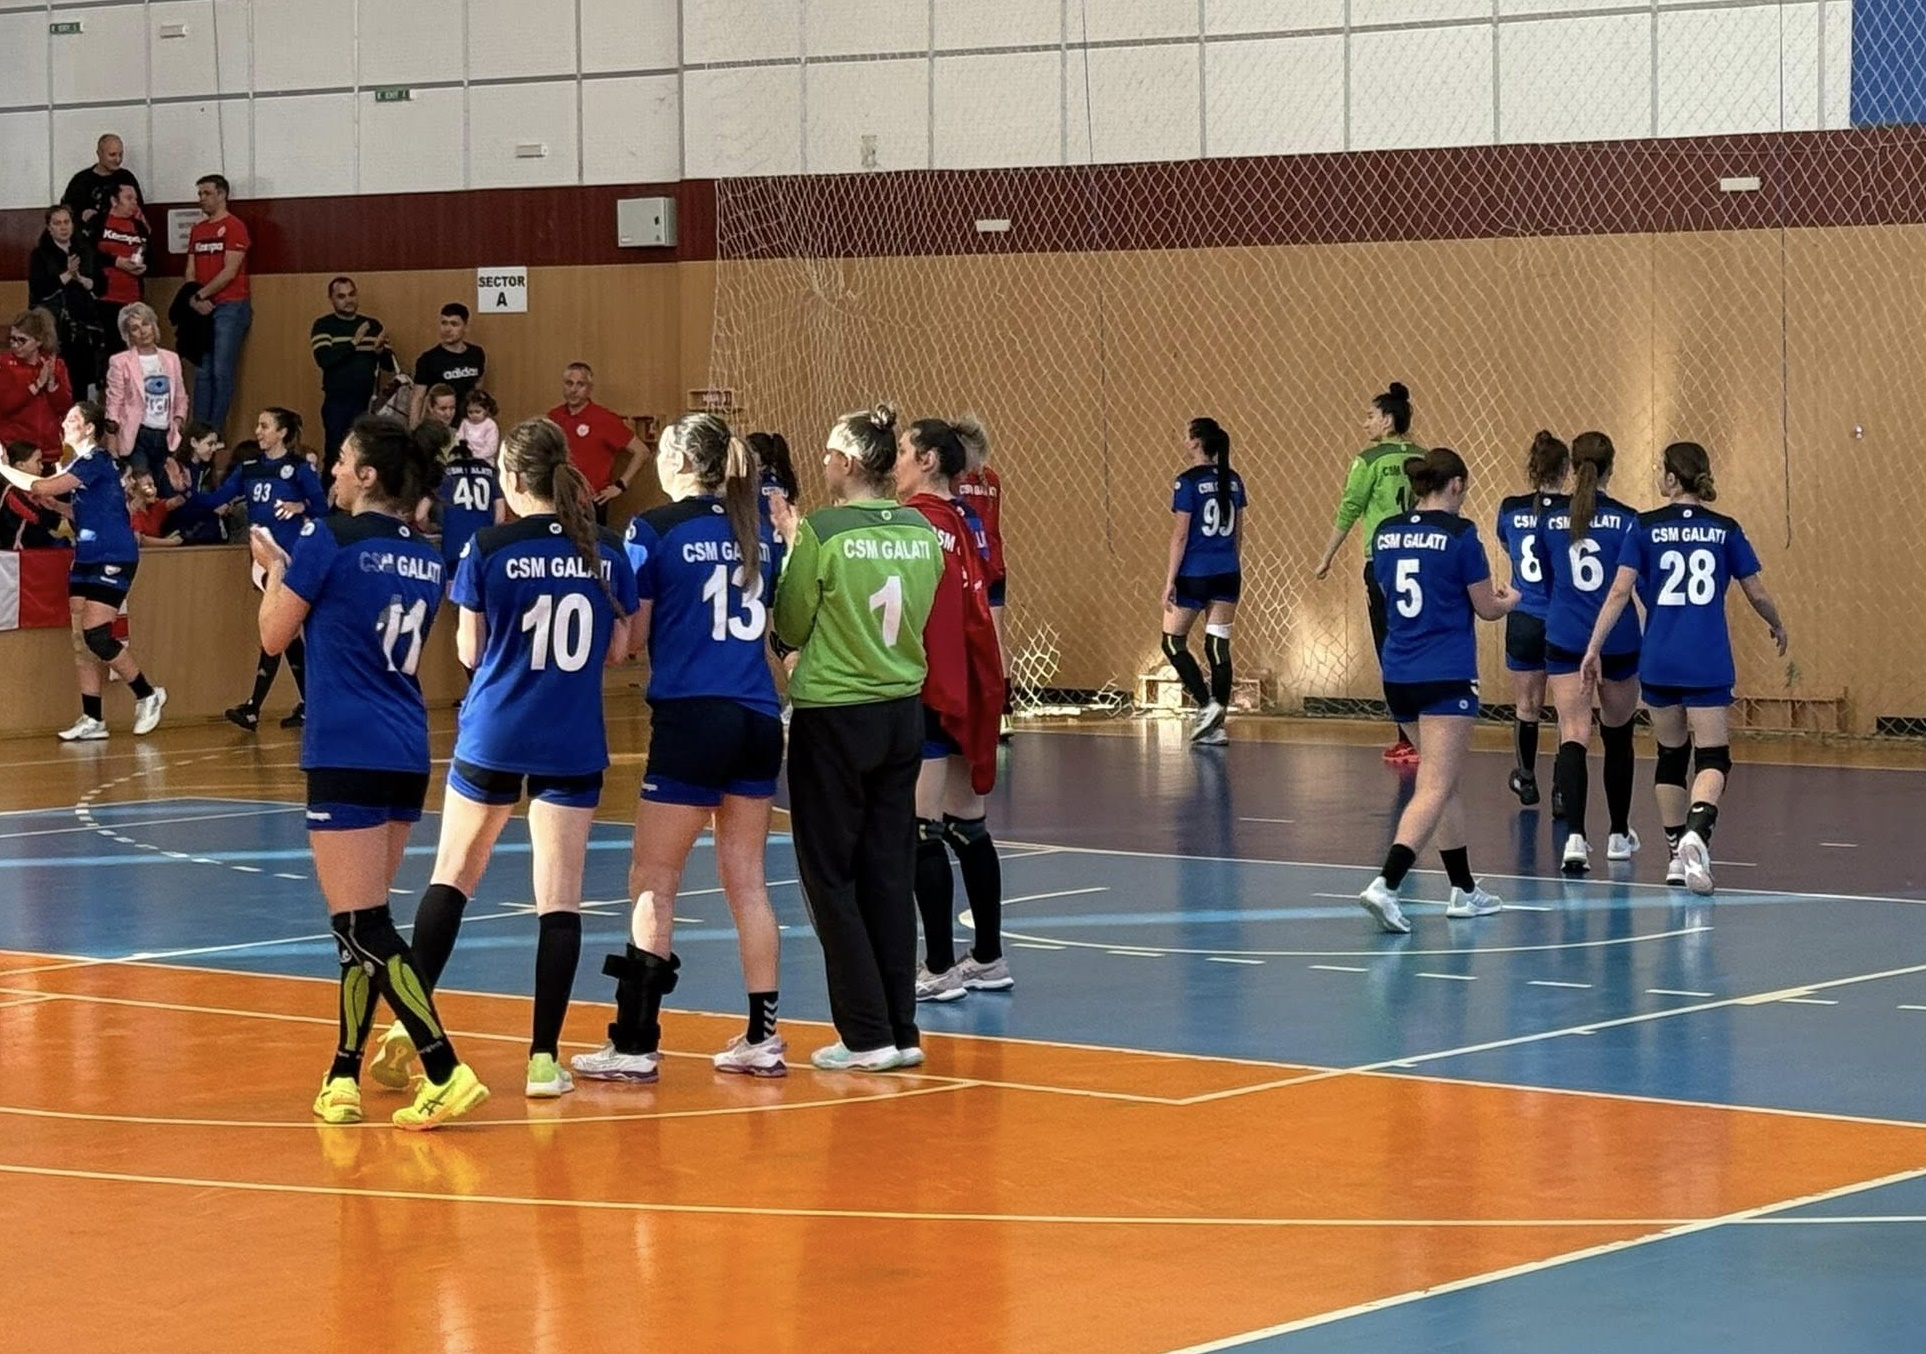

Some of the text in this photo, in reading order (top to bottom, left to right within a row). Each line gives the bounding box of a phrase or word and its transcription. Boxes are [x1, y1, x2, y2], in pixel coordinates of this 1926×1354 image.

[478, 275, 526, 288] SECTOR
[496, 291, 508, 307] A
[252, 482, 272, 502] 93
[453, 476, 490, 511] 40
[1589, 514, 1621, 531] LATI
[1377, 533, 1448, 551] CSM GALATI
[1650, 526, 1727, 545] CSM GALATI
[682, 541, 719, 563] CSM
[843, 538, 931, 560] CSM GALATI
[505, 556, 547, 579] CSM
[1568, 538, 1605, 592] 6
[1395, 557, 1424, 619] 5
[1656, 548, 1717, 606] 28
[702, 564, 768, 642] 13
[868, 574, 903, 648] 1
[521, 592, 594, 673] 10
